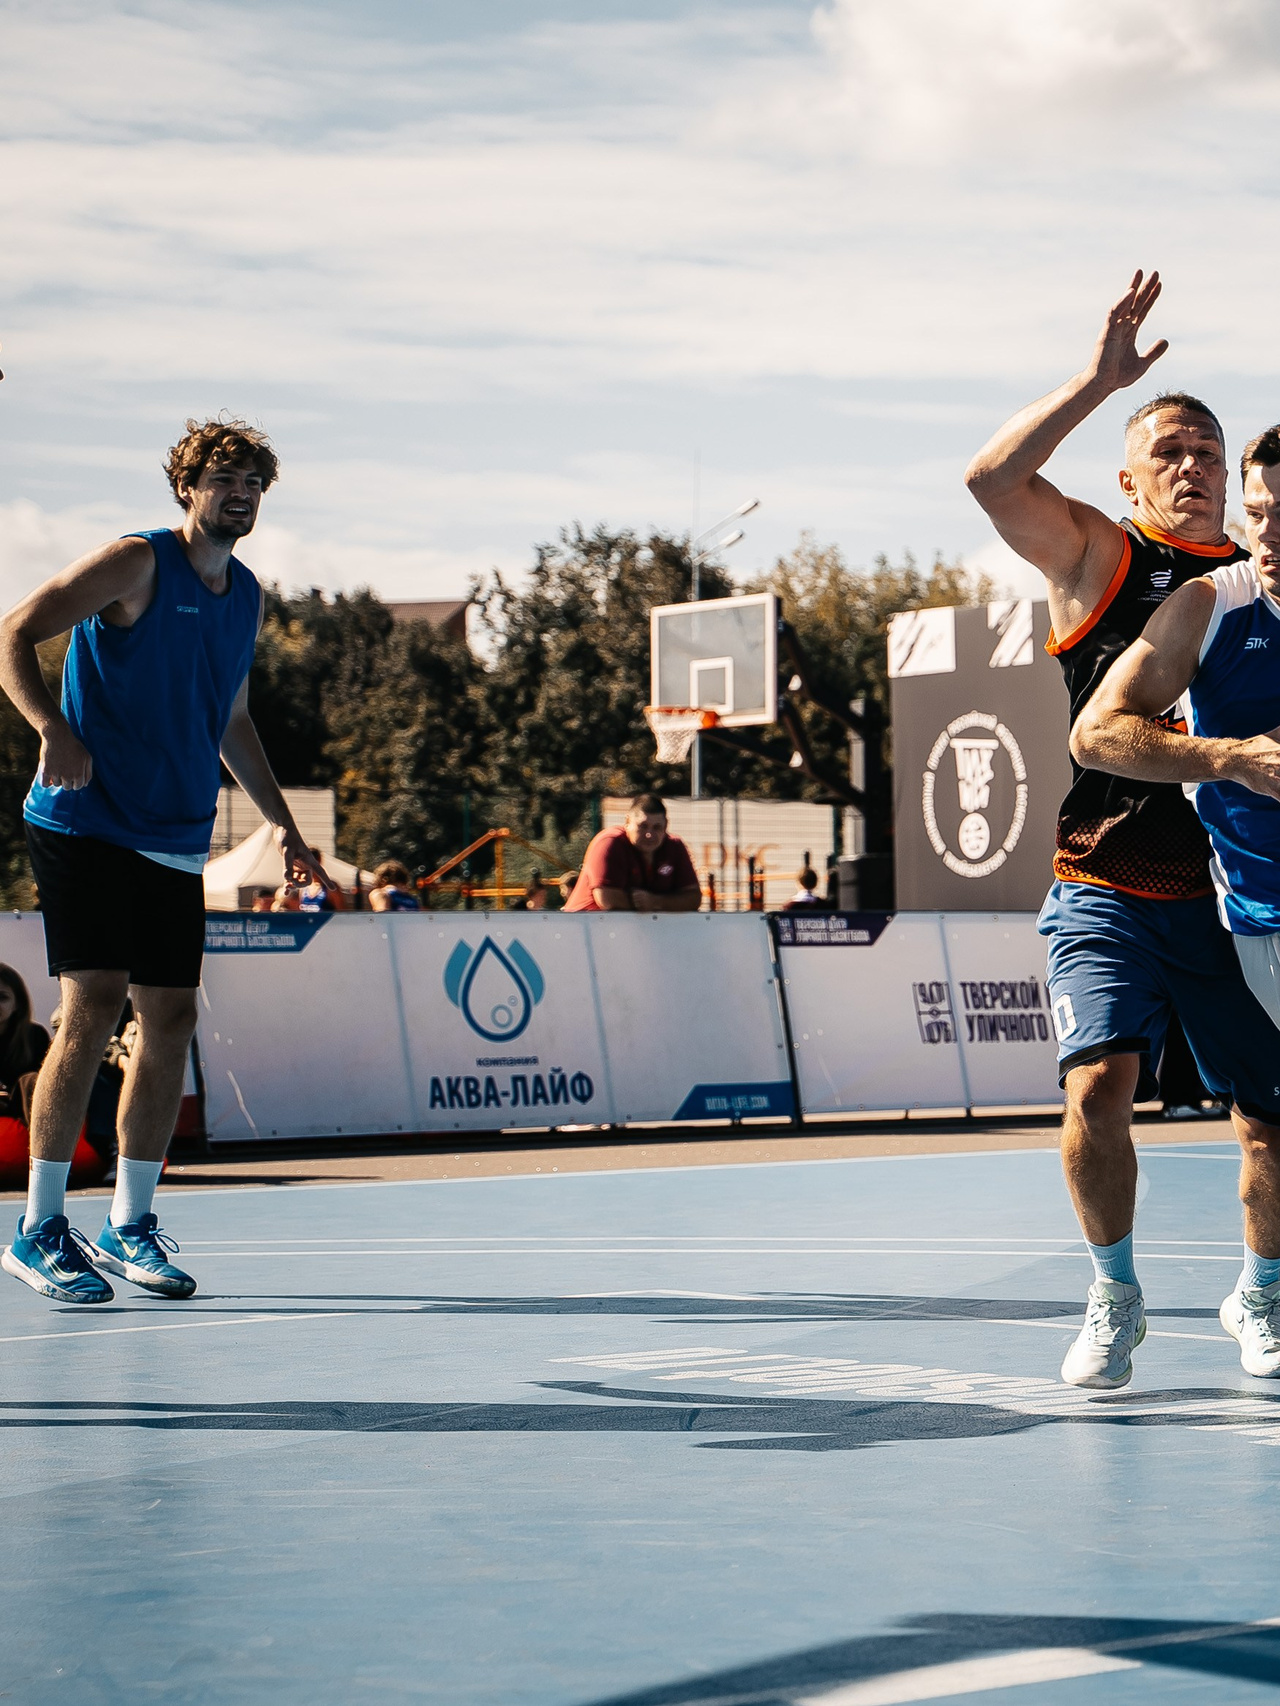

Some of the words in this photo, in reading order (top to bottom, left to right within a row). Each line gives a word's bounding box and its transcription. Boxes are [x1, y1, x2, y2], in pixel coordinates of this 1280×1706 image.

[1244, 637, 1270, 649] STK
[959, 979, 1042, 1009] ТВЕРСКОЙ
[965, 1014, 1048, 1042] УЛИЧНОГО
[429, 1067, 595, 1109] АКВА-ЛАЙФ
